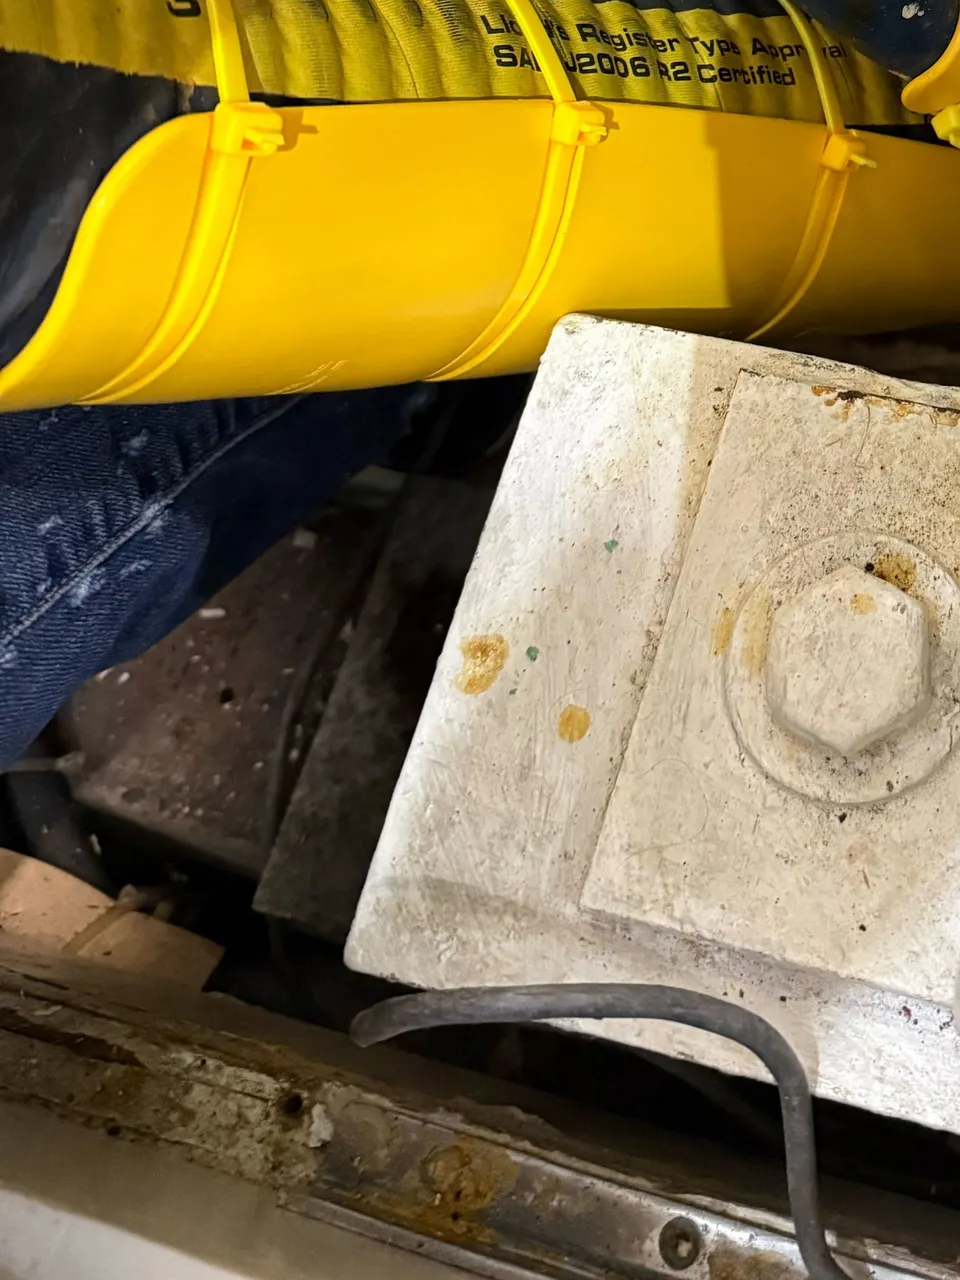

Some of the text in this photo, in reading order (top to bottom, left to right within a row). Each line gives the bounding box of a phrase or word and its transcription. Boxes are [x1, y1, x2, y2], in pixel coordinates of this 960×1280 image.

[575, 23, 680, 52] Register
[684, 36, 741, 58] Type
[752, 37, 848, 62] Appral
[564, 51, 651, 78] J2006
[656, 59, 692, 82] R2
[697, 63, 796, 87] Certified
